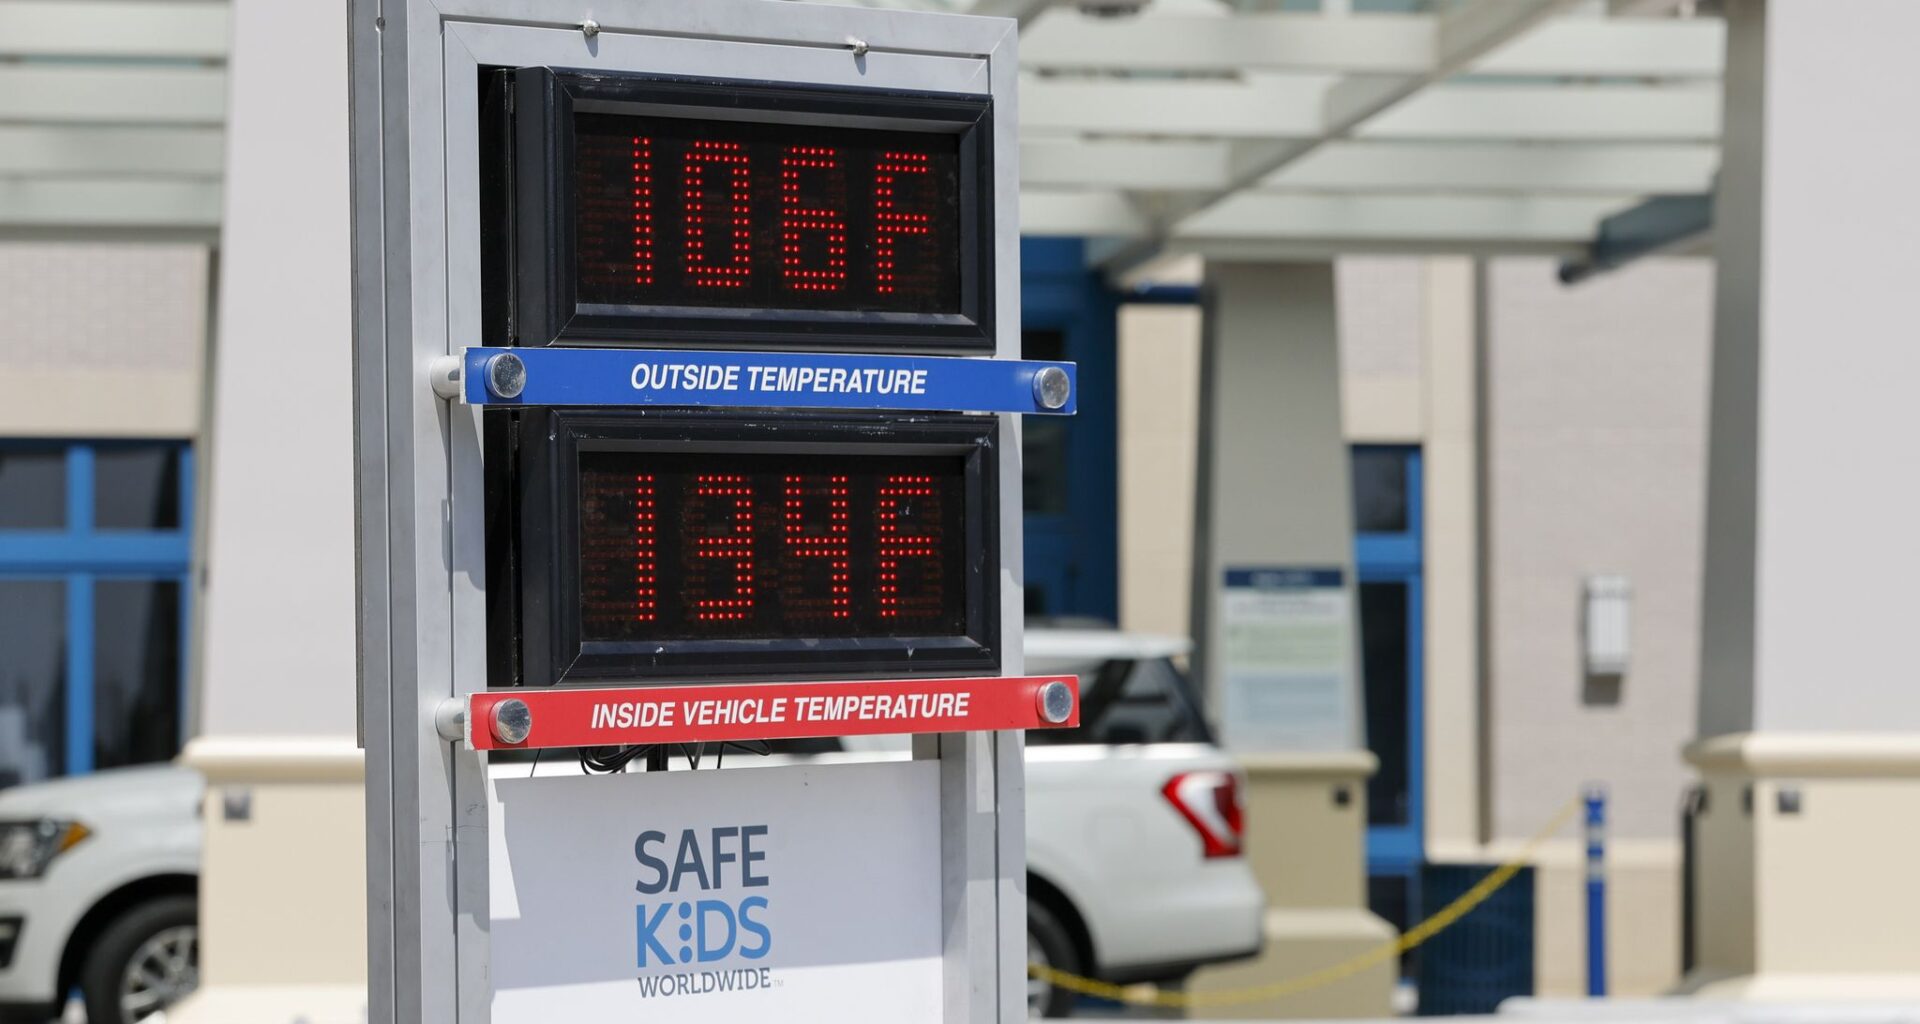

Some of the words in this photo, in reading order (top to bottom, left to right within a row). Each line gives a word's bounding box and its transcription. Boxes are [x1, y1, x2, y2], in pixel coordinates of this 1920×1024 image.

[630, 363, 740, 392] OUTSIDE
[747, 366, 928, 395] TEMPERATURE
[590, 701, 674, 729] INSIDE
[683, 696, 786, 725] VEHICLE
[794, 692, 971, 722] TEMPERATURE
[634, 825, 769, 895] SAFE
[637, 967, 771, 998] WORLDWIDE
